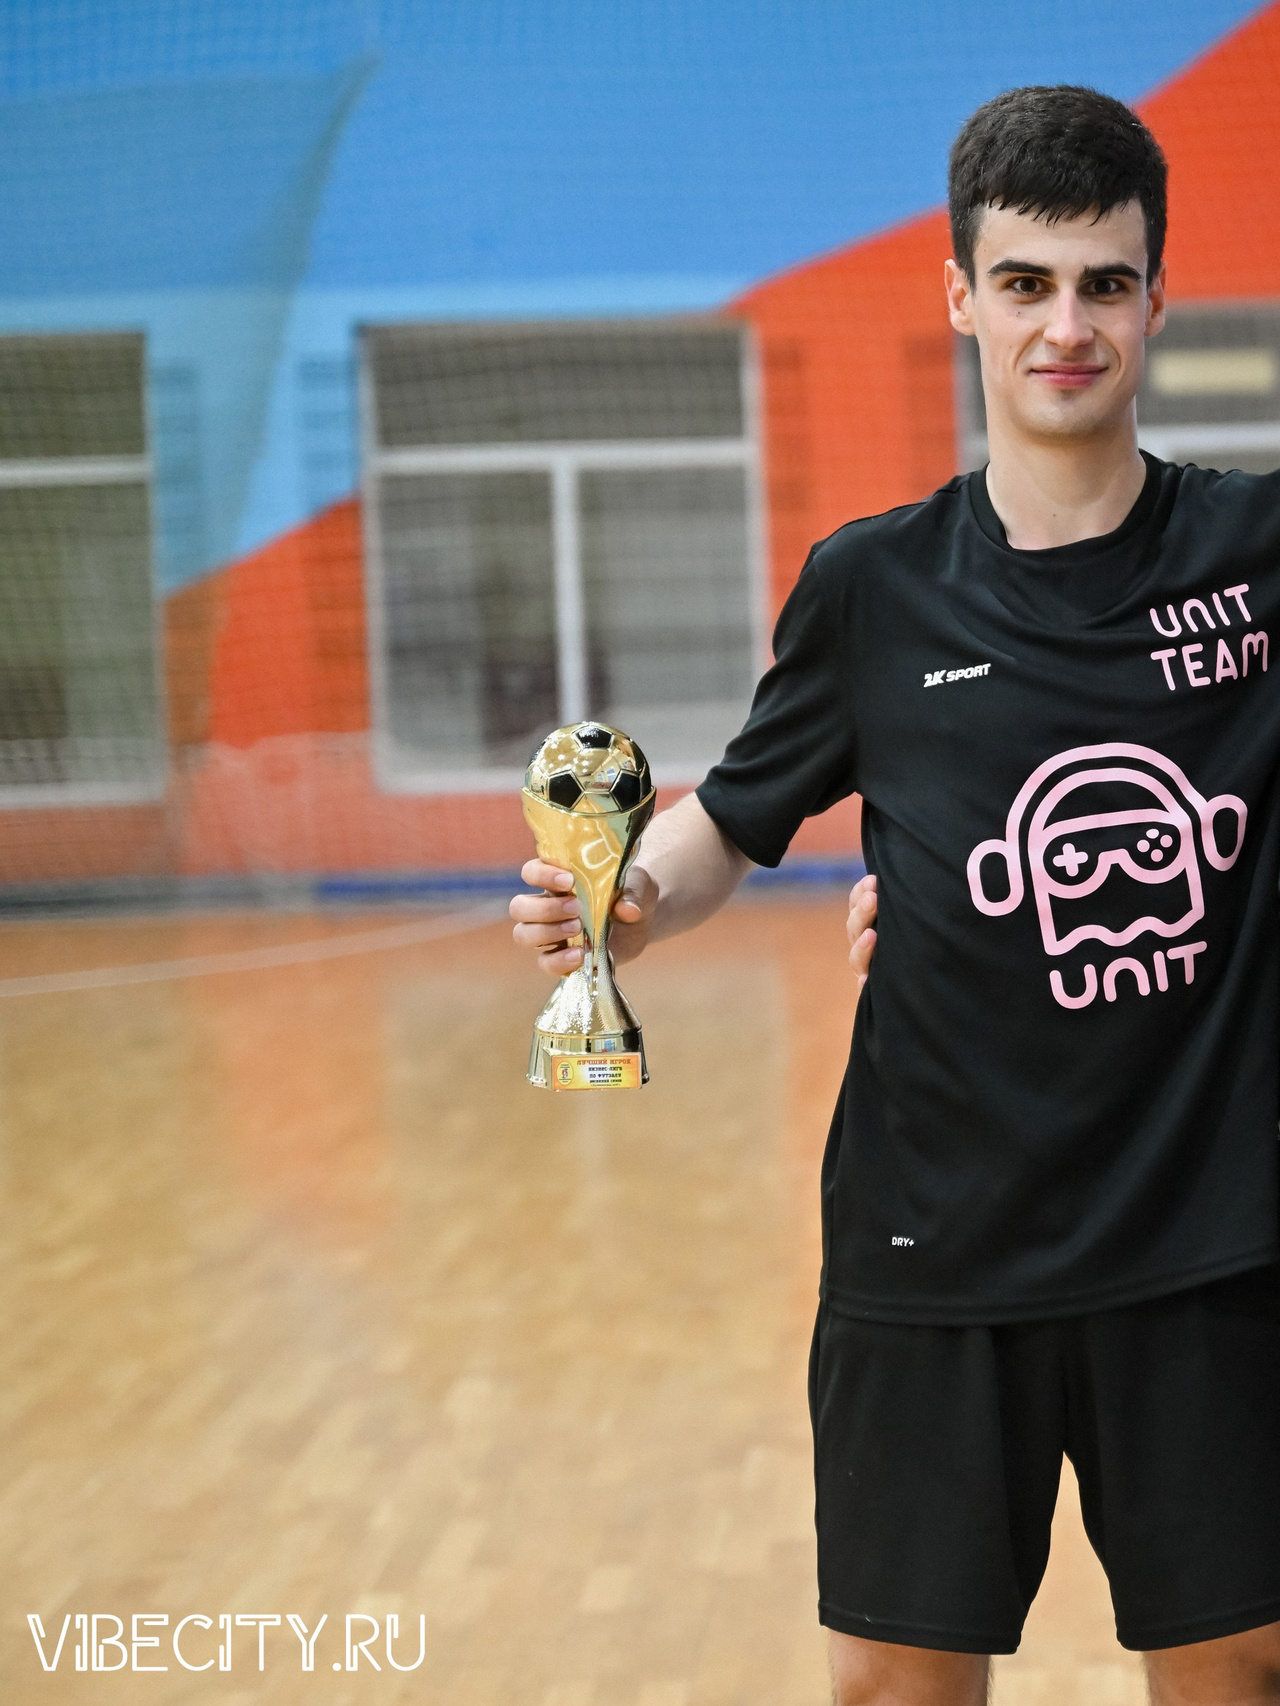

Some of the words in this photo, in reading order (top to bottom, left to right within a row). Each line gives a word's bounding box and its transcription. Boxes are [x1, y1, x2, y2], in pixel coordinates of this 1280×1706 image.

[1150, 583, 1252, 637] UNIT
[923, 669, 946, 688] 2K
[946, 662, 991, 683] SPORT
[1150, 630, 1270, 691] TEAM
[1049, 940, 1208, 1010] UNIT
[891, 1236, 915, 1247] DRY+
